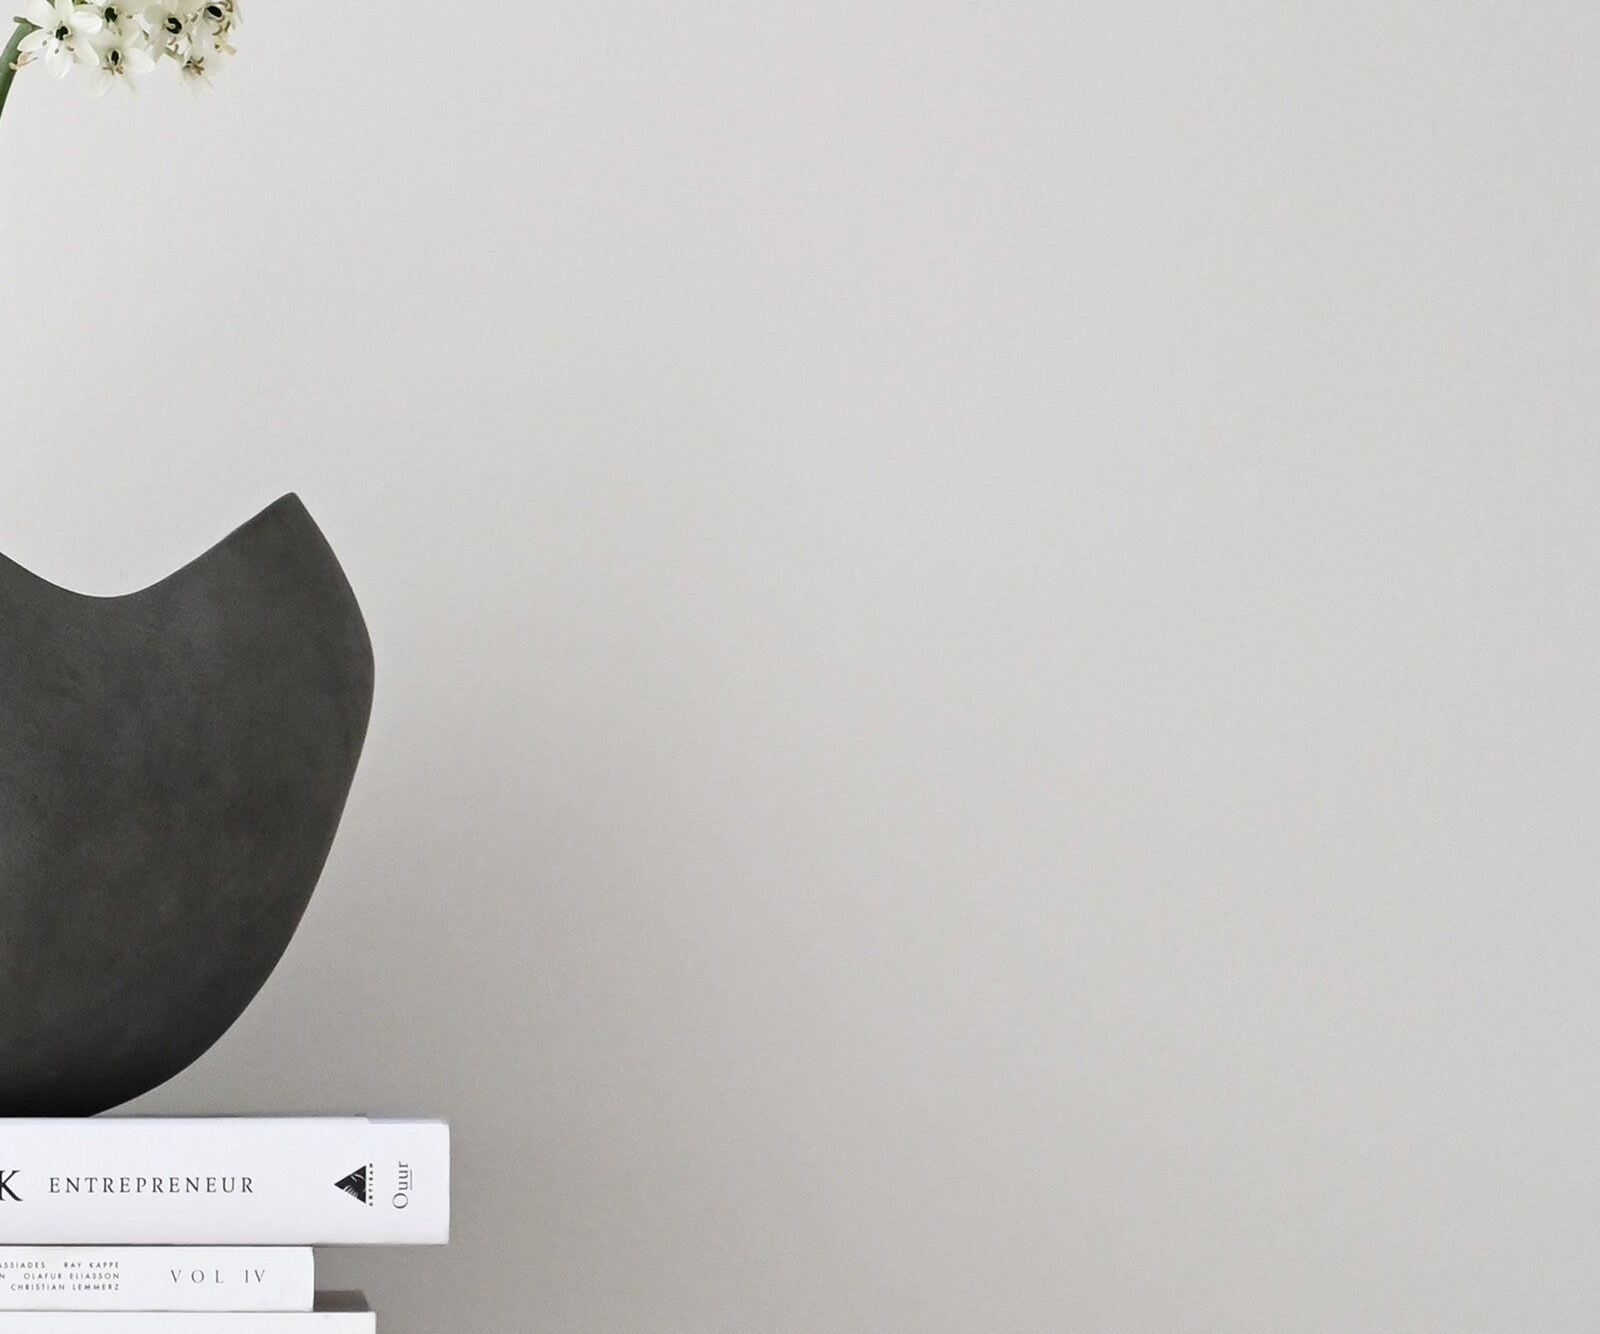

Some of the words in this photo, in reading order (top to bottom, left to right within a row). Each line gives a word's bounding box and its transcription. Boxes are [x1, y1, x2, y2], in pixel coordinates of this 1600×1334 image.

[49, 1176, 253, 1194] ENTREPRENEUR
[392, 1161, 410, 1210] Ouur
[63, 1261, 82, 1269] RAY
[88, 1261, 119, 1269] KAPPE
[23, 1272, 62, 1281] OLAFUR
[69, 1272, 120, 1281] ELIASSON
[170, 1269, 224, 1284] VOL
[245, 1269, 265, 1284] IV
[10, 1283, 66, 1292] CHRISTIAN
[72, 1283, 120, 1292] LEMMERZ
